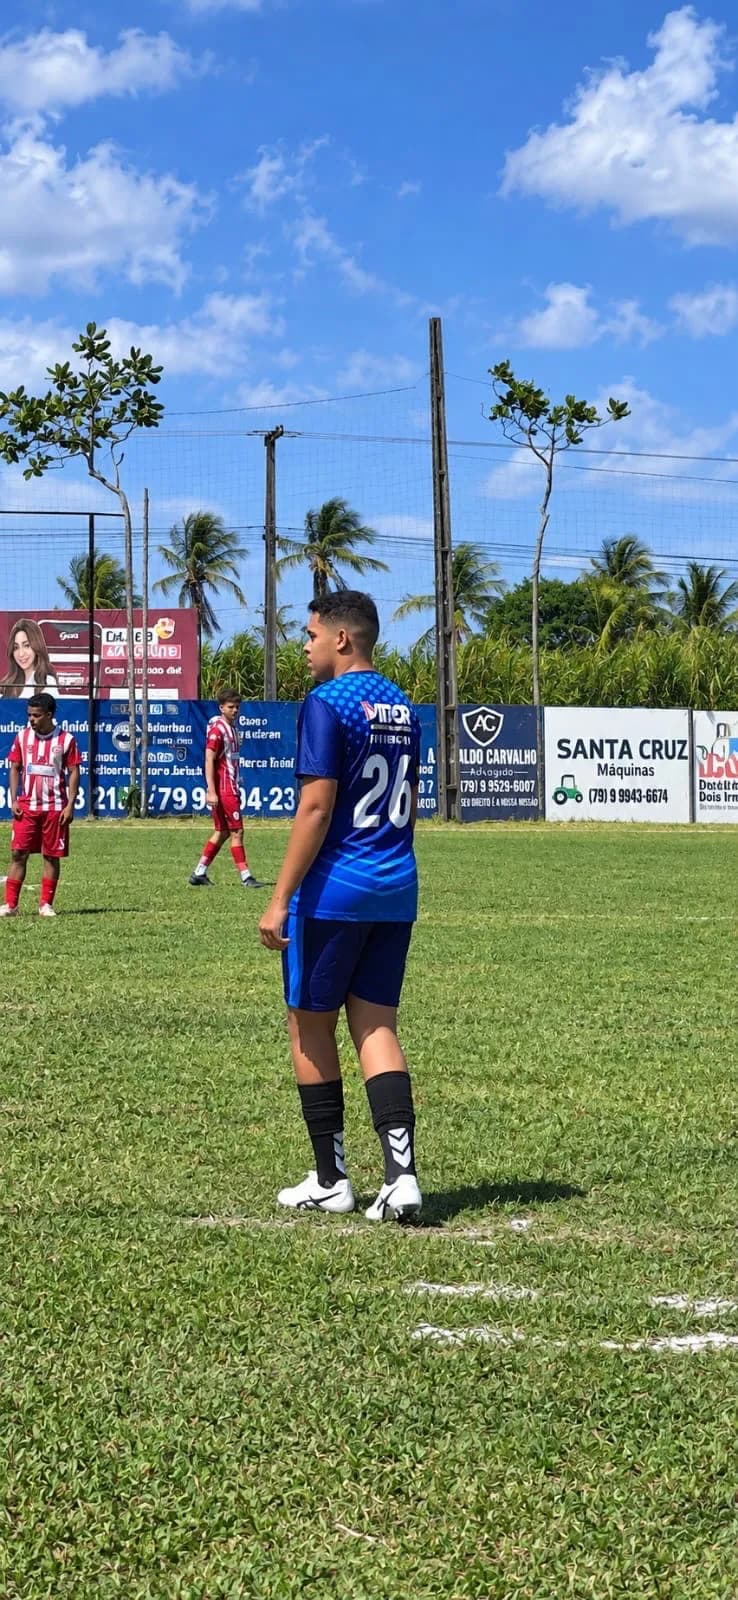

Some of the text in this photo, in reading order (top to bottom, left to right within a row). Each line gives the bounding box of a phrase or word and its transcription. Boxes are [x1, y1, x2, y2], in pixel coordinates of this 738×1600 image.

[472, 714, 496, 732] AC
[486, 749, 537, 765] CARVALHO
[557, 738, 689, 760] SANTA CRUZ
[597, 763, 655, 780] Máquinas
[353, 753, 412, 829] 26
[460, 780, 535, 794] (79) 9 9529-6007
[588, 788, 668, 804] (79) 9 9943-6674
[699, 791, 721, 802] Dois
